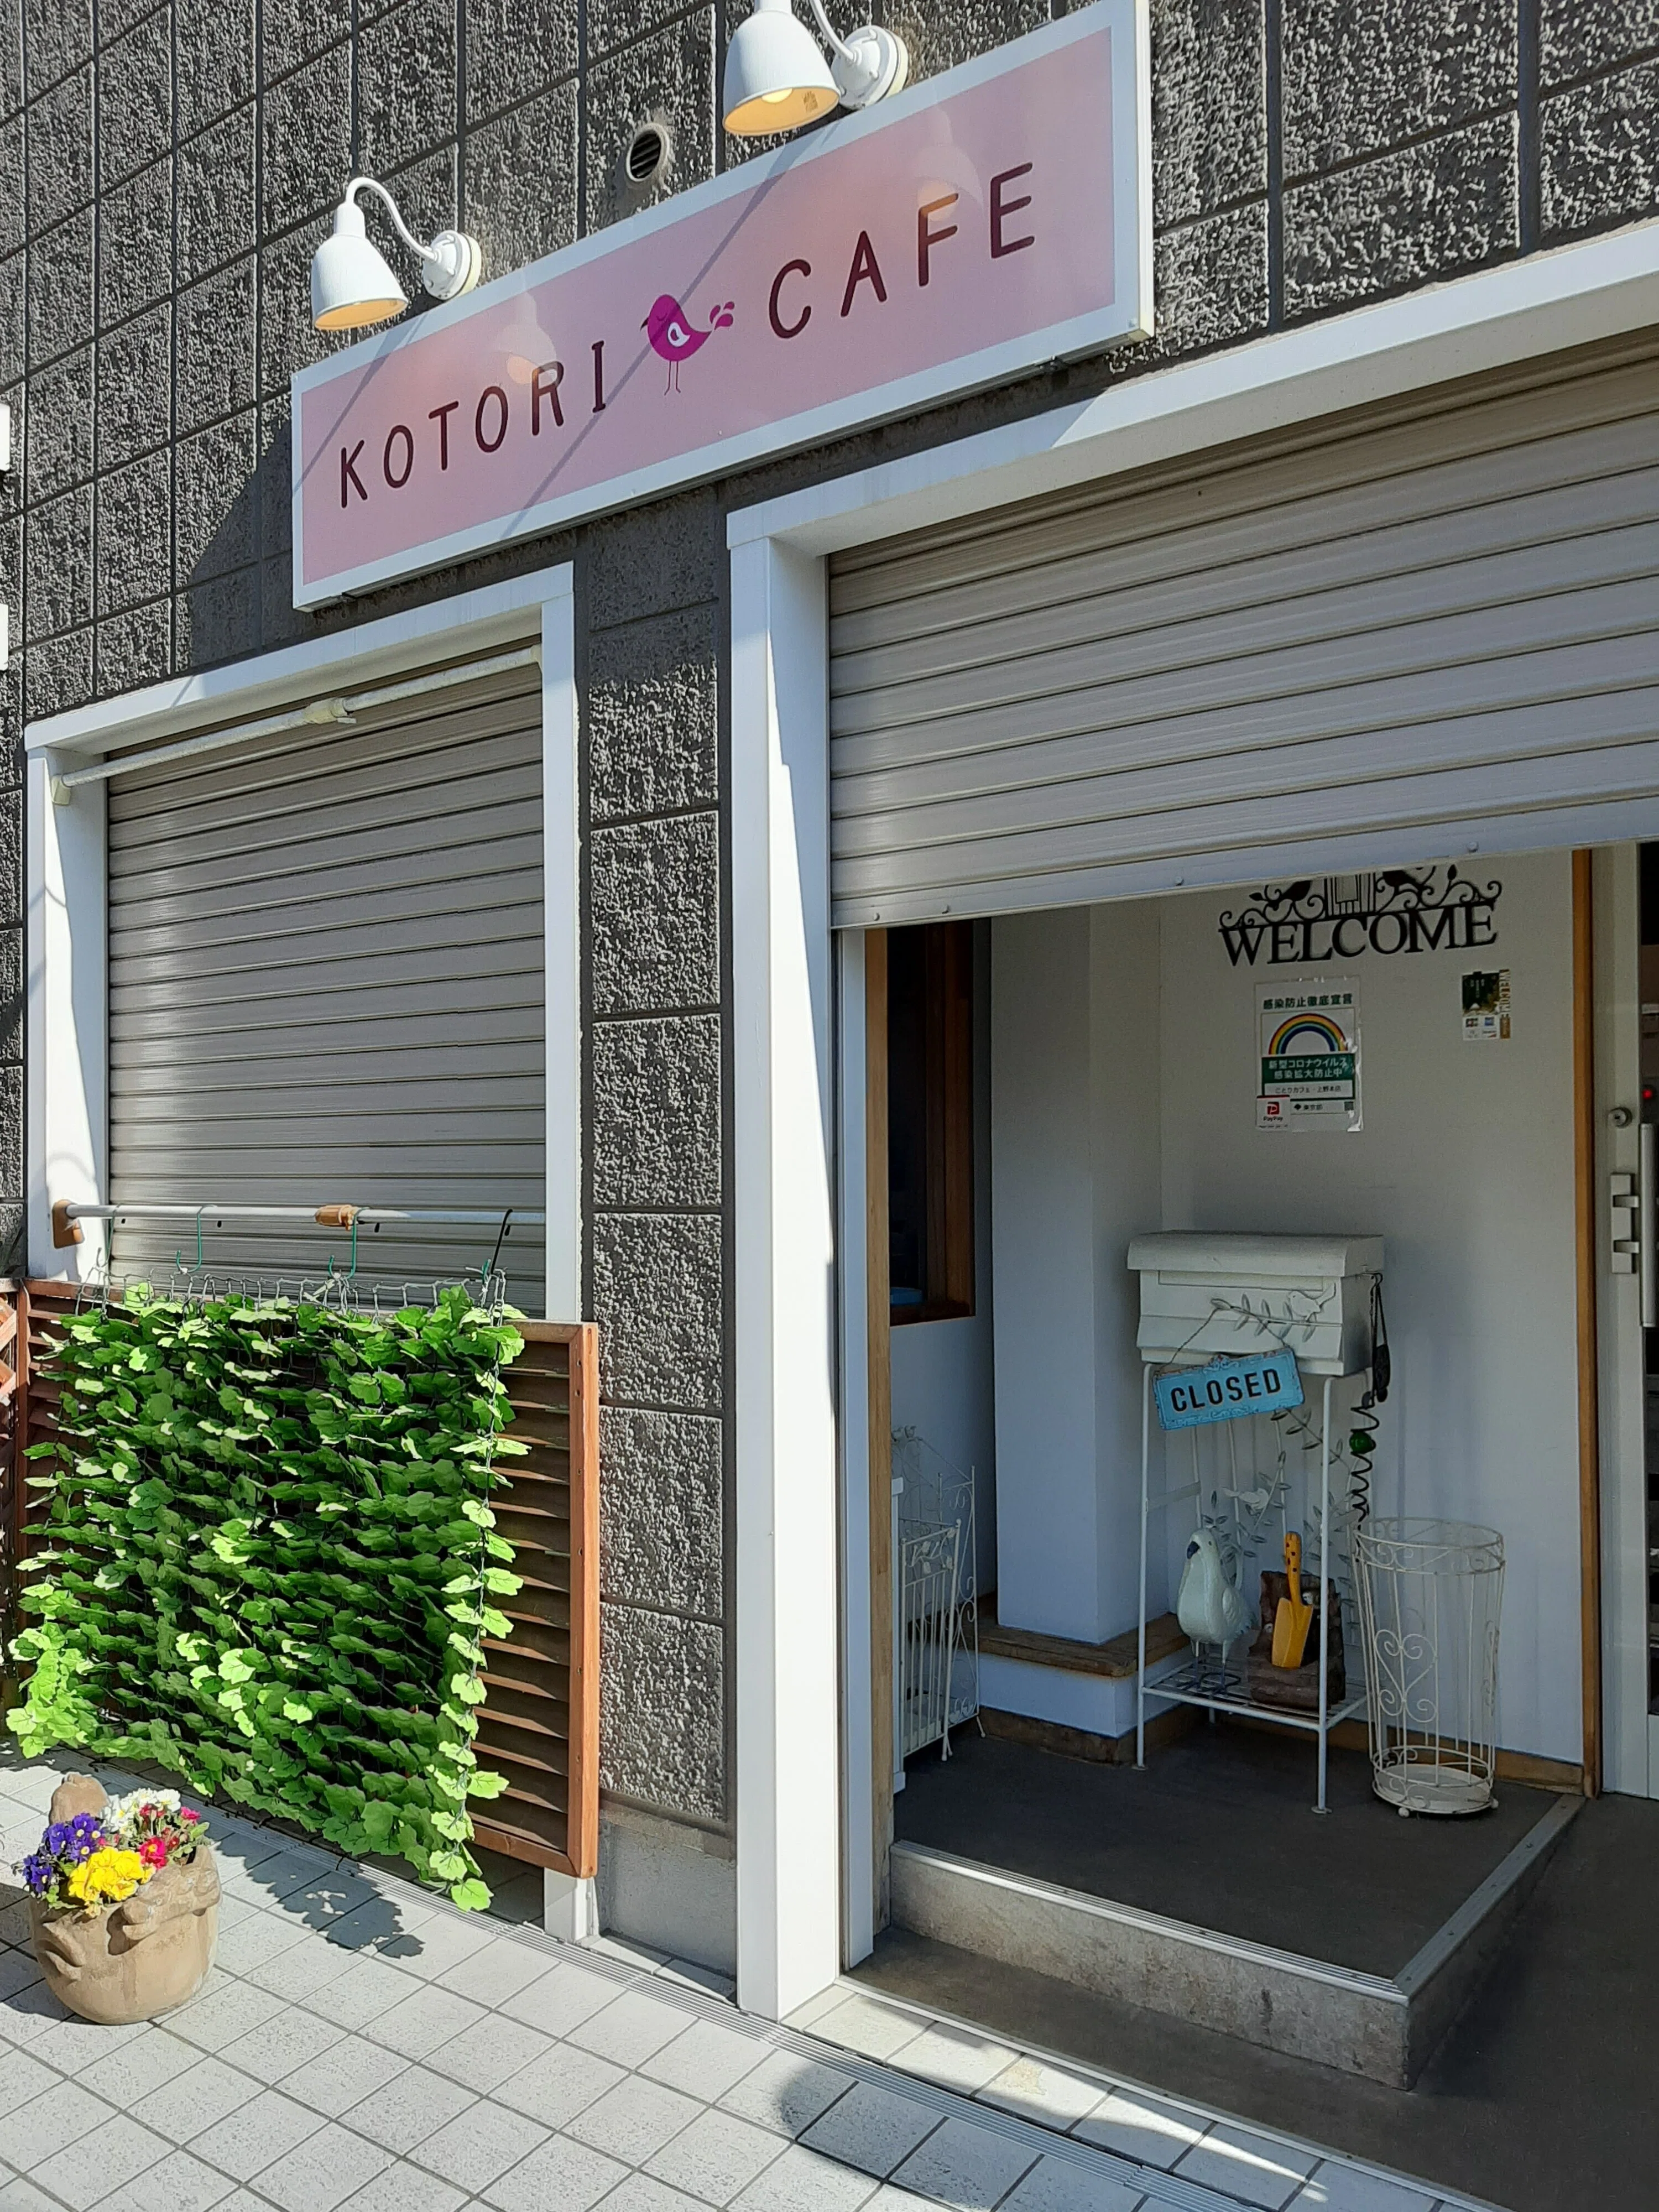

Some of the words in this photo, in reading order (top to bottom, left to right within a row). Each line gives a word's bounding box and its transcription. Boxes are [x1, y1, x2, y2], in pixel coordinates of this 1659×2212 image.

[340, 340, 606, 509] KOTORI
[768, 161, 1035, 339] CAFE
[1218, 900, 1498, 966] WELCOME
[1263, 993, 1353, 1010] 感染防止徹底宣言
[1269, 1057, 1348, 1070] 新型コロナウイルス
[1274, 1068, 1343, 1079] 感染拡大防止中
[1171, 1368, 1281, 1412] CLOSED
